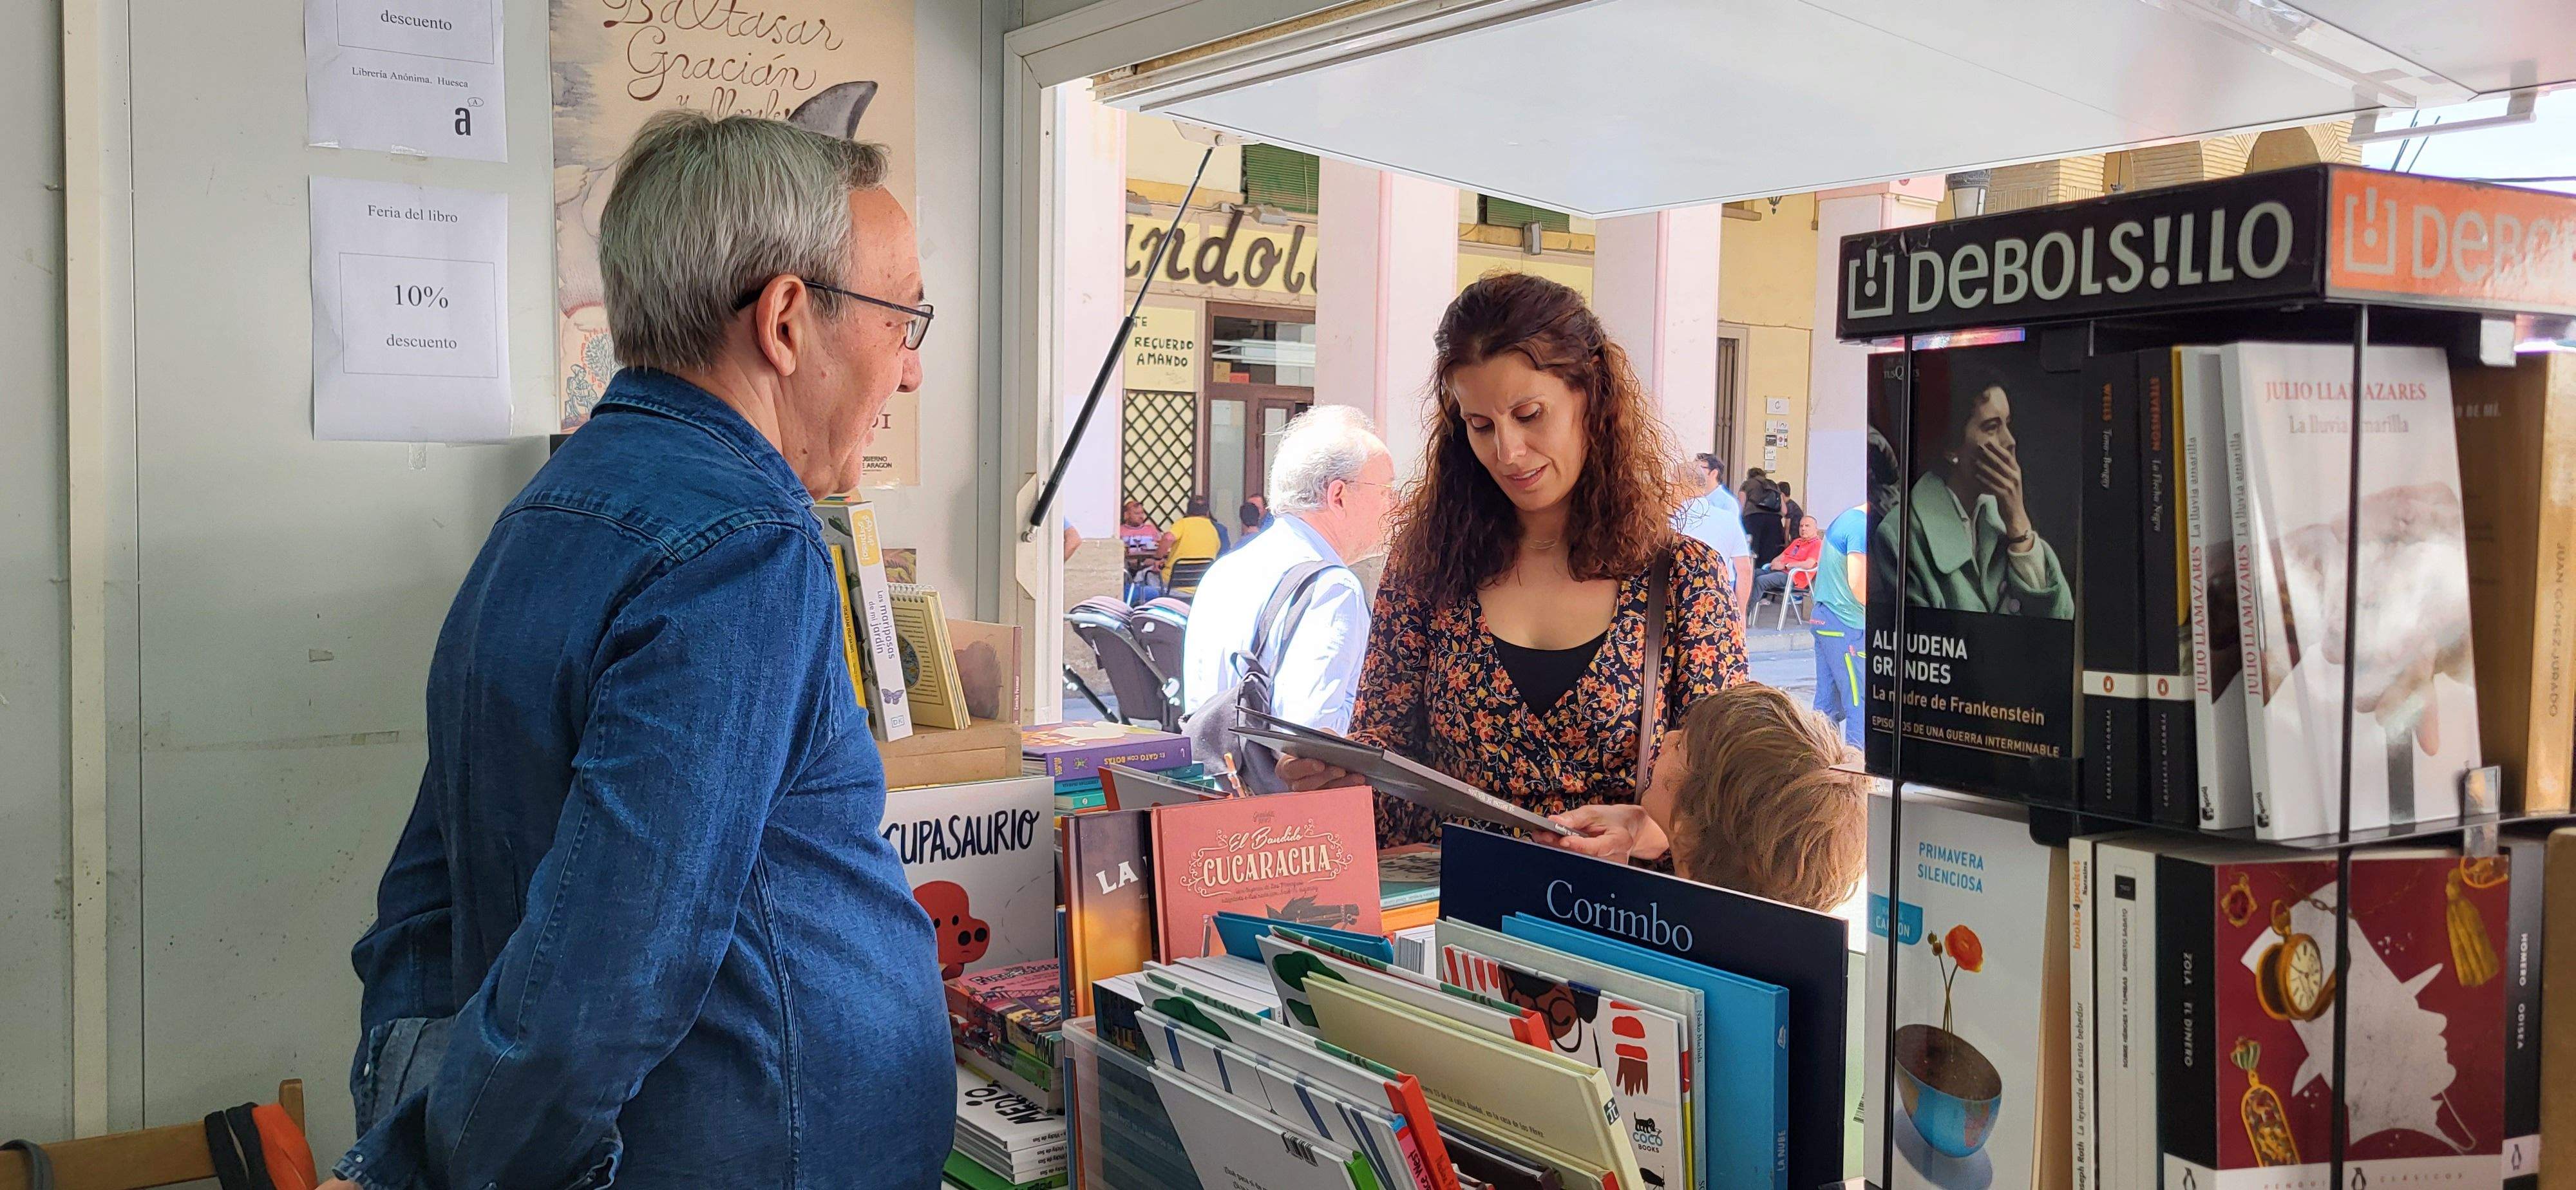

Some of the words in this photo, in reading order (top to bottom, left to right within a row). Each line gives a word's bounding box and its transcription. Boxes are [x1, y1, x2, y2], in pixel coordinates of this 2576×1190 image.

[380, 10, 452, 31] descuento
[352, 66, 387, 79] Librería
[390, 71, 433, 84] Anónima.
[437, 76, 468, 88] Huesca
[627, 26, 817, 101] Gracián
[455, 107, 471, 136] a
[368, 204, 401, 220] Feria
[404, 207, 424, 222] del
[428, 209, 458, 223] libro
[1126, 211, 1318, 295] ndol
[393, 283, 449, 309] 10%
[386, 334, 458, 350] descuento
[1134, 336, 1195, 351] RECUERDO
[1136, 352, 1188, 368] AMANDO
[2266, 382, 2313, 402] JULIO
[2317, 381, 2428, 401] LLAAZARES
[2149, 376, 2162, 451] STEVENSON
[2289, 415, 2306, 433] La
[2308, 414, 2349, 435] lluvia
[2190, 523, 2201, 538] La
[2236, 522, 2248, 537] La
[868, 601, 876, 612] de
[876, 589, 886, 603] Las
[2190, 545, 2207, 645] LLAMAZARES
[2238, 545, 2255, 646] LLAMAZARES
[869, 612, 878, 622] mi
[869, 622, 886, 655] jardín
[879, 604, 896, 660] mariposas
[1872, 629, 1968, 660] ALUDENA
[1873, 655, 1951, 685] GRNDES
[2195, 650, 2210, 694] JULIO
[2245, 651, 2260, 695] JULIO
[1872, 685, 1886, 700] La
[1931, 694, 1947, 710] de
[1950, 696, 2045, 726] Frankenstein
[1913, 722, 1924, 735] DE
[1926, 725, 1944, 739] UNA
[1946, 729, 1982, 746] GUERRA
[1984, 735, 2060, 758] INTERMINABLE
[1103, 756, 1126, 765] BOTAS
[1140, 752, 1159, 761] GATO
[1228, 832, 1249, 853] El
[1251, 826, 1303, 850] Bandido
[1203, 844, 1332, 887] CUCARACHA
[1918, 841, 1985, 872] PRIMAVERA
[1095, 860, 1139, 895] LA
[1917, 864, 1984, 894] SILENCIOSA
[1546, 880, 1694, 952] Corimbo
[2184, 952, 2193, 985] ZOLA
[2518, 932, 2529, 987] HOMERO
[2075, 1001, 2083, 1040] bebedor
[2184, 1002, 2192, 1015] EL
[2517, 1003, 2526, 1050] ODISEA
[2184, 1018, 2193, 1068] DINERO
[2075, 1070, 2083, 1084] del
[2076, 1088, 2087, 1122] leyenda
[1632, 1131, 1663, 1147] COCO
[1777, 1129, 1786, 1160] NUBE
[2076, 1124, 2084, 1136] La
[1638, 1144, 1660, 1153] BOOKS
[2077, 1141, 2085, 1163] Roth
[1776, 1160, 1786, 1171] LA
